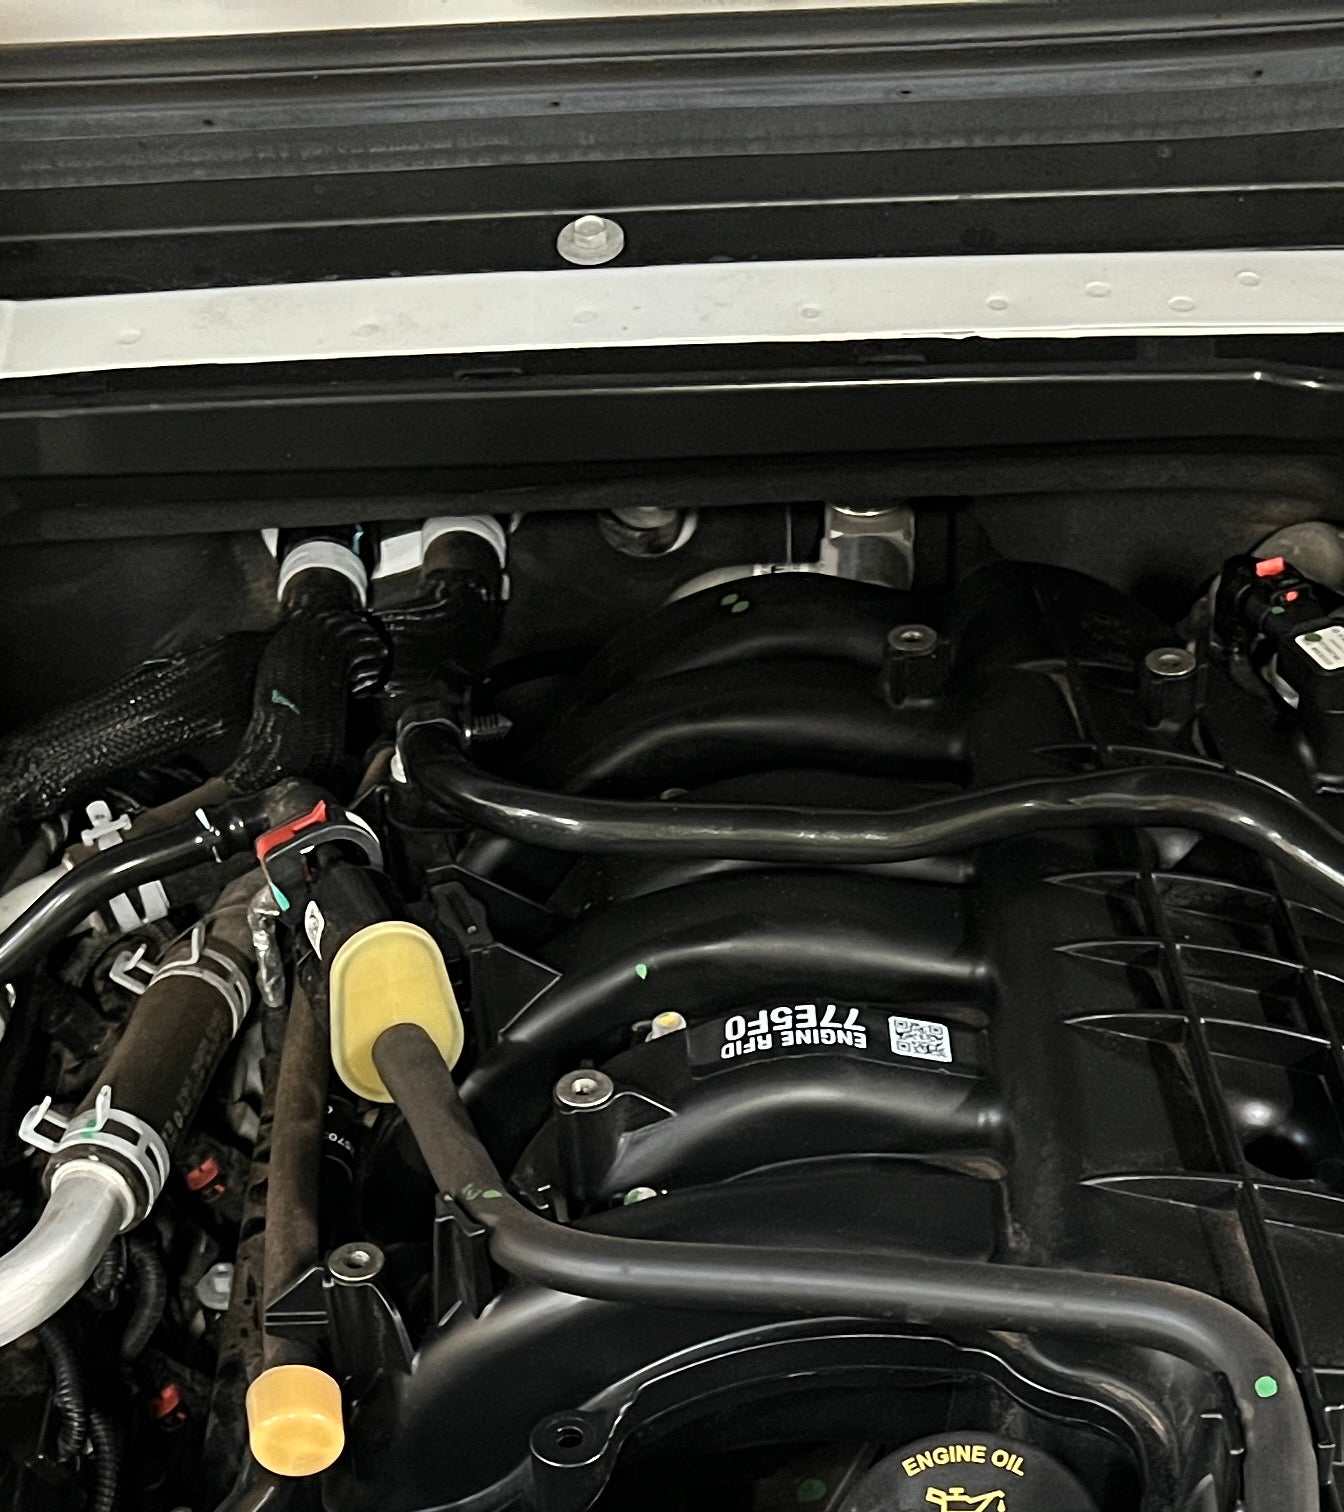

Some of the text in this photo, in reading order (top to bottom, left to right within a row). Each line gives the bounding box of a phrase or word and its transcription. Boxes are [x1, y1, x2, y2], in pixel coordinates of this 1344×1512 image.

[725, 1004, 867, 1041] 77E5F0
[720, 1028, 867, 1059] ENGINE RFID
[901, 1445, 1025, 1477] ENGINE OIL
